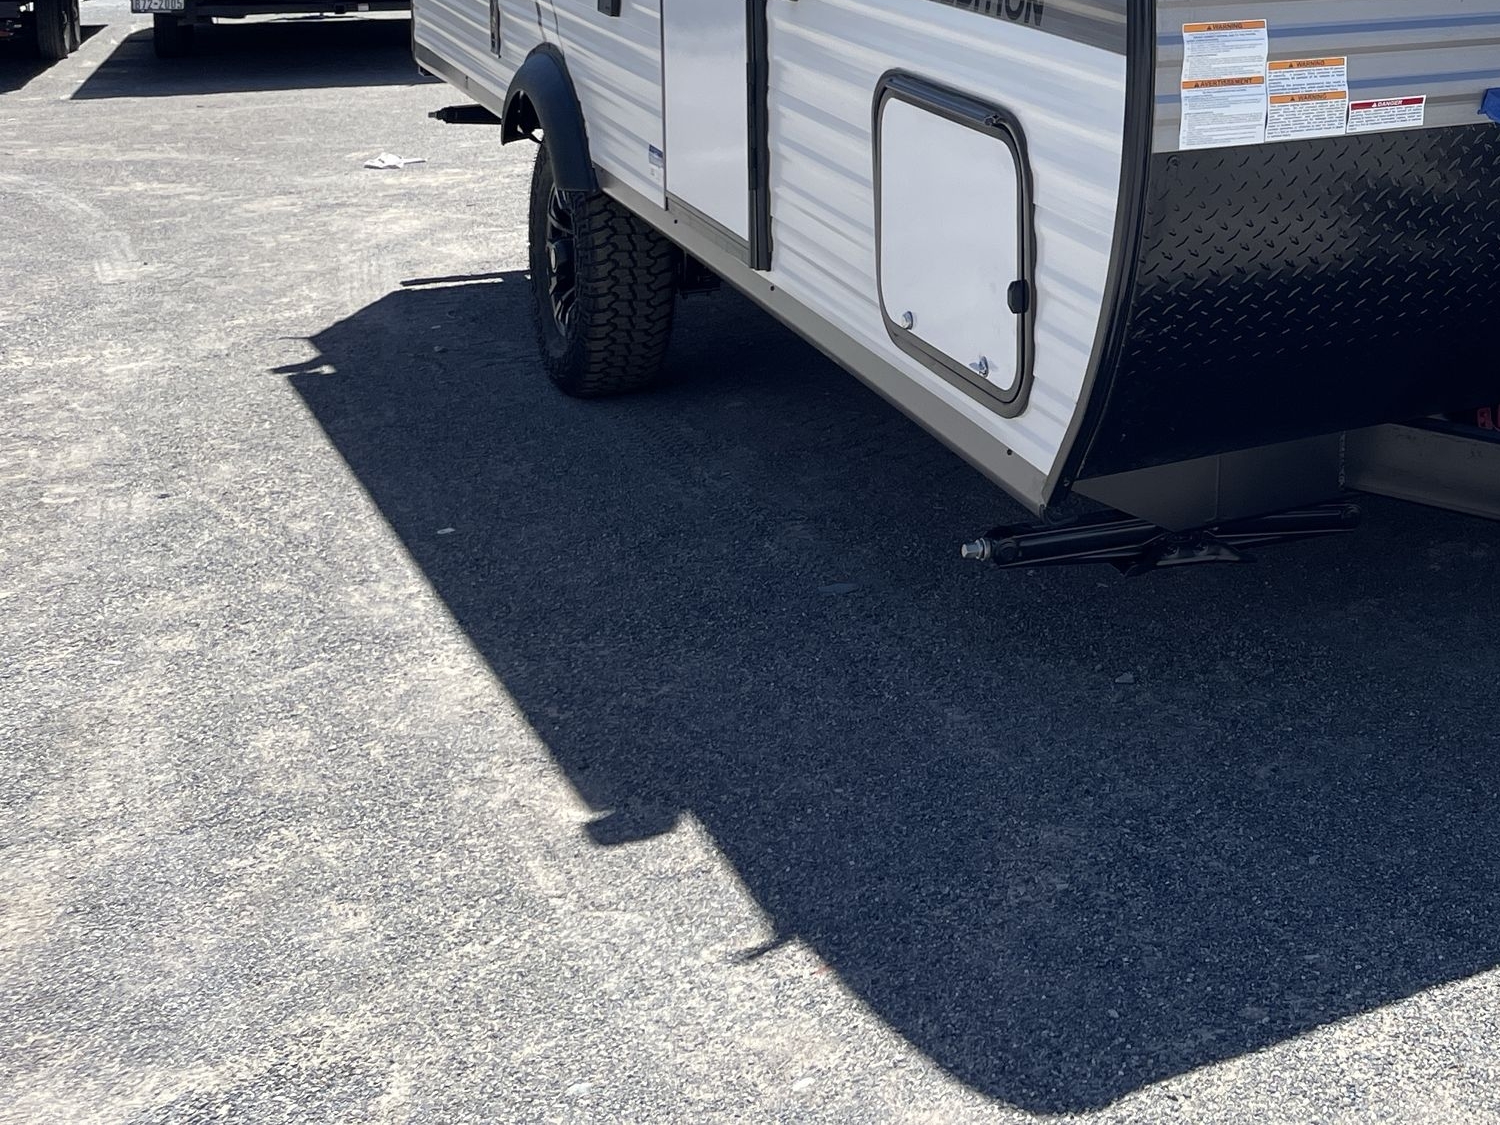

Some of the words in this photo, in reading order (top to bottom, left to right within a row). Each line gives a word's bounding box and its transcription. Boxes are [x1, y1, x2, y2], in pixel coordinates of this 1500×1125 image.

[1213, 22, 1243, 30] WARNING
[1296, 59, 1325, 67] WARNING
[1201, 76, 1253, 88] AVERTISSEMENT
[1297, 93, 1328, 102] WARNING
